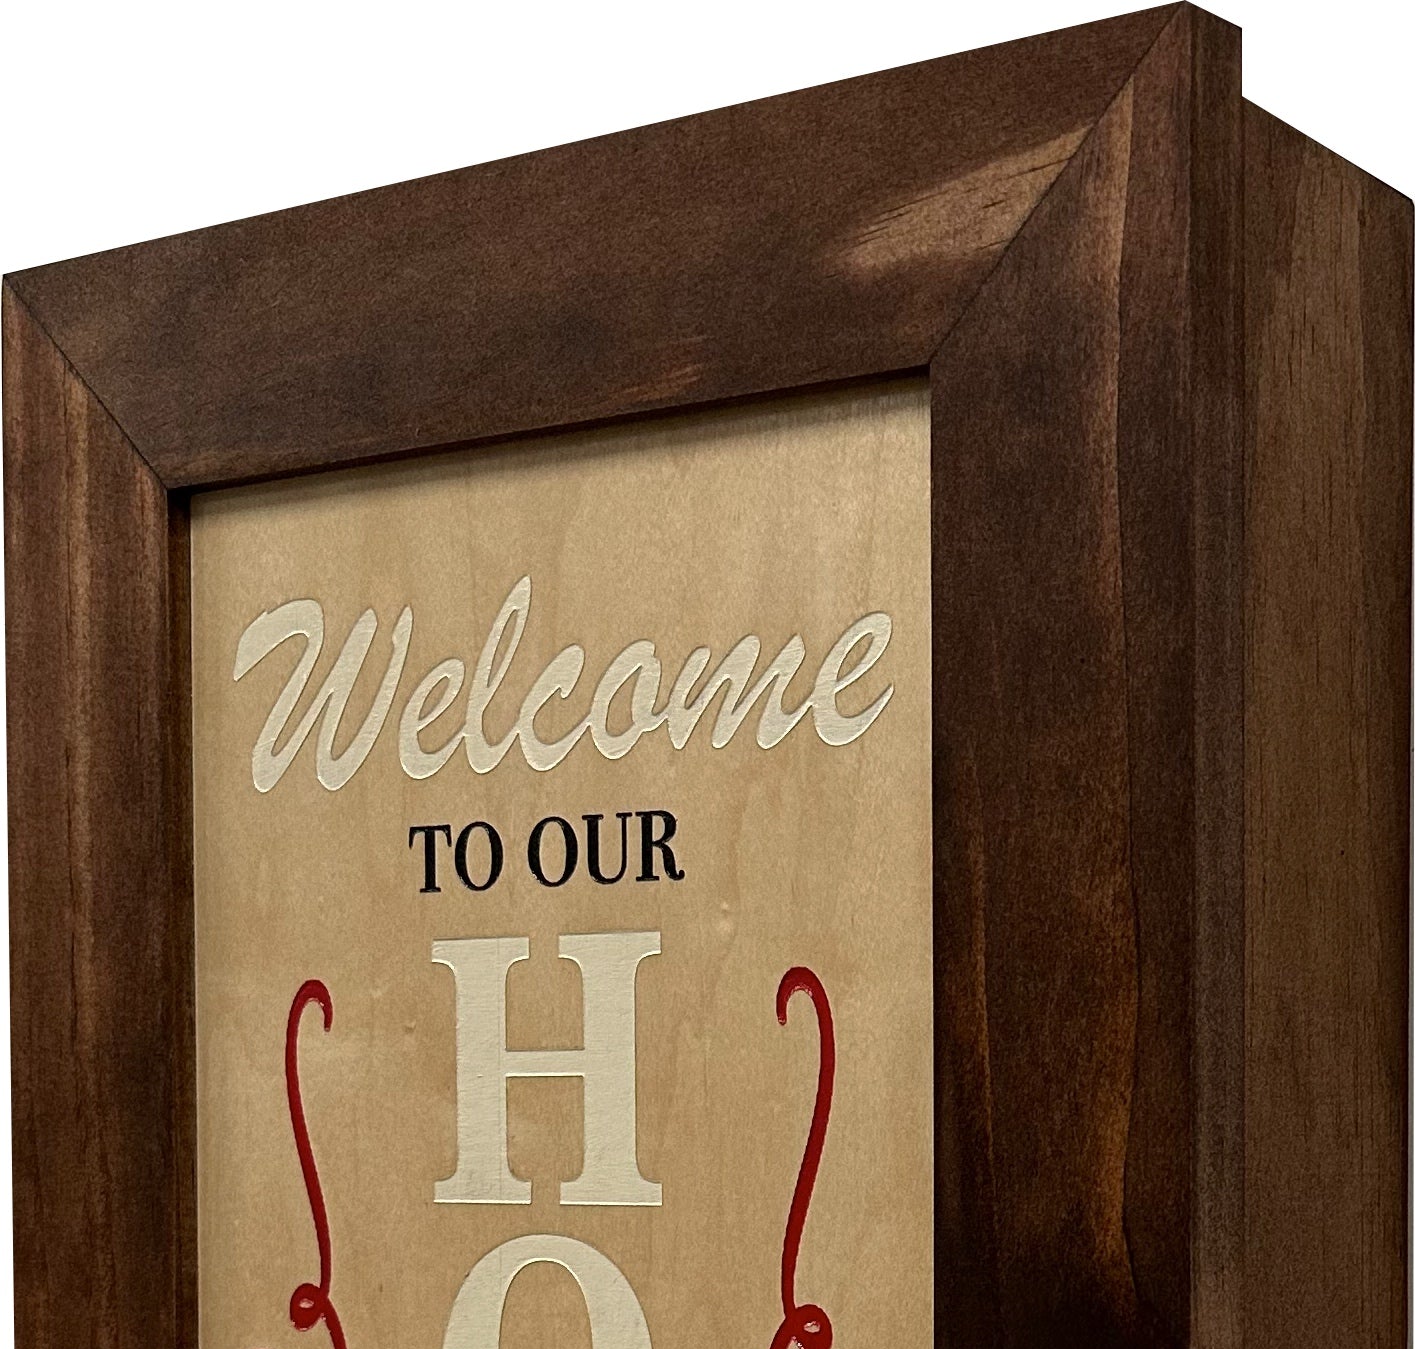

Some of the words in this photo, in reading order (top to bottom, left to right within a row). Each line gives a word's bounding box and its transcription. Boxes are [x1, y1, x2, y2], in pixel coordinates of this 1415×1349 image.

[232, 574, 895, 794] Welcome
[408, 821, 505, 894] TO
[526, 810, 686, 888] OUR
